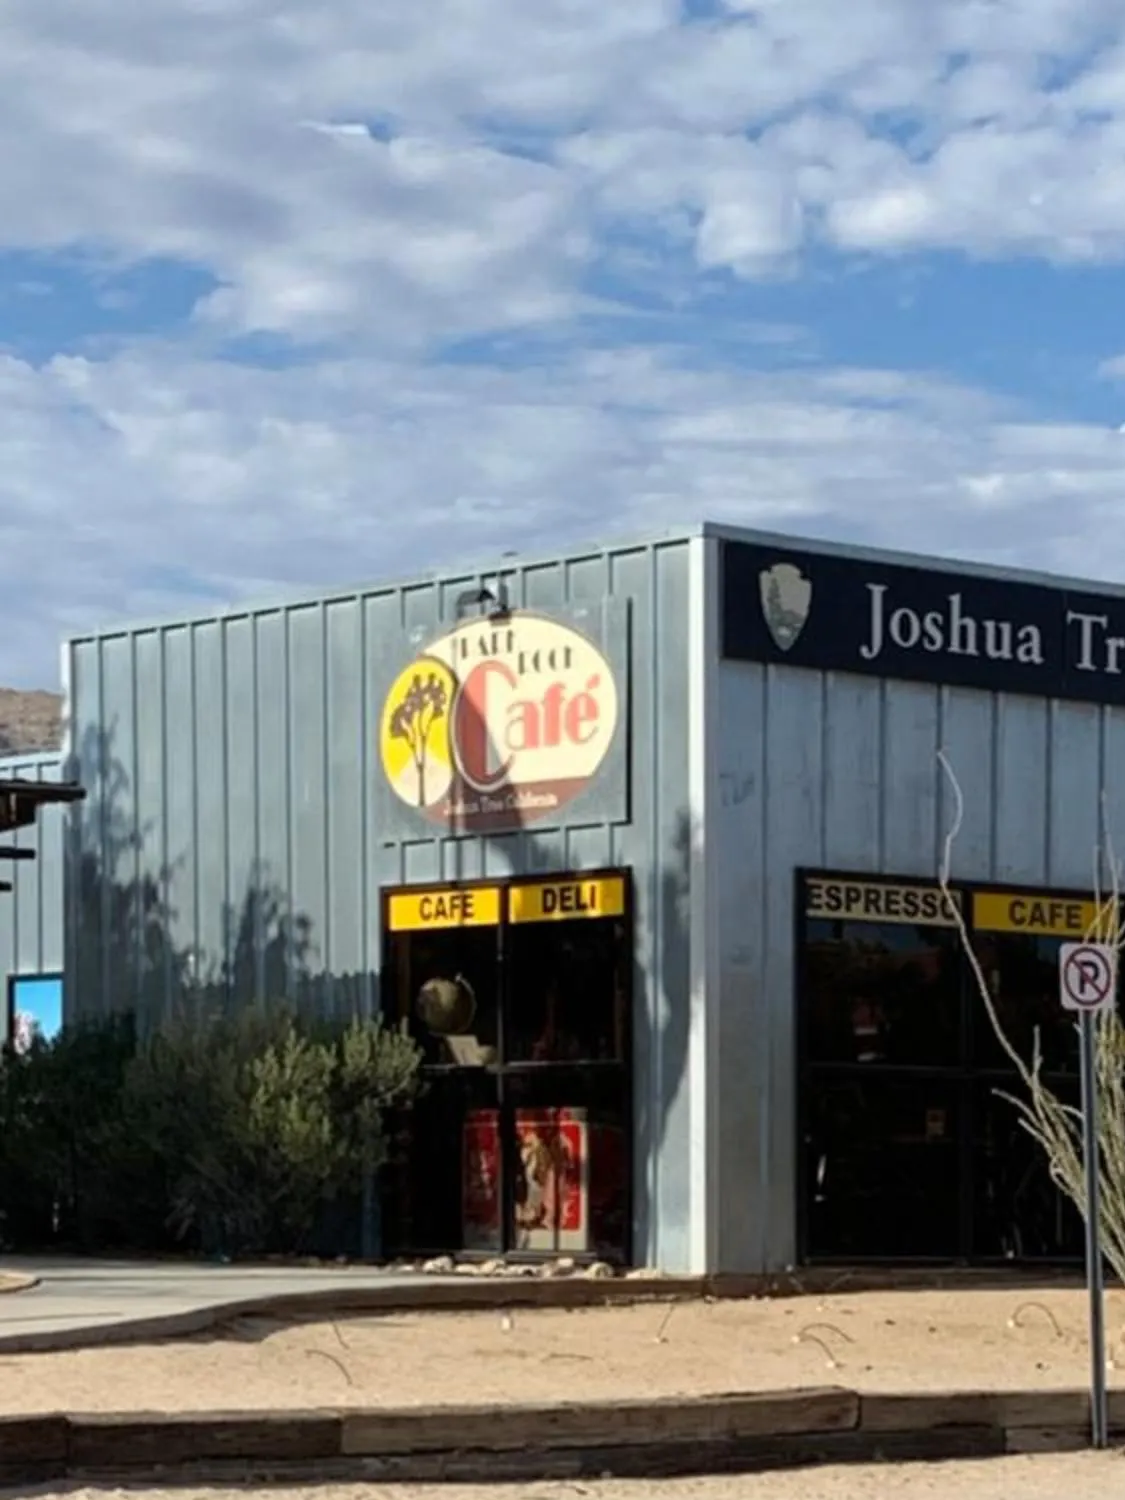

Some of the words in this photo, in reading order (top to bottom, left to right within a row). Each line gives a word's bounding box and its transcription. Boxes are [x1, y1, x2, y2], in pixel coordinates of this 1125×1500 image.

[859, 582, 1044, 666] Joshua
[453, 659, 600, 787] Café
[418, 893, 476, 922] CAFE
[541, 884, 597, 914] DELI
[1008, 899, 1083, 929] CAFE
